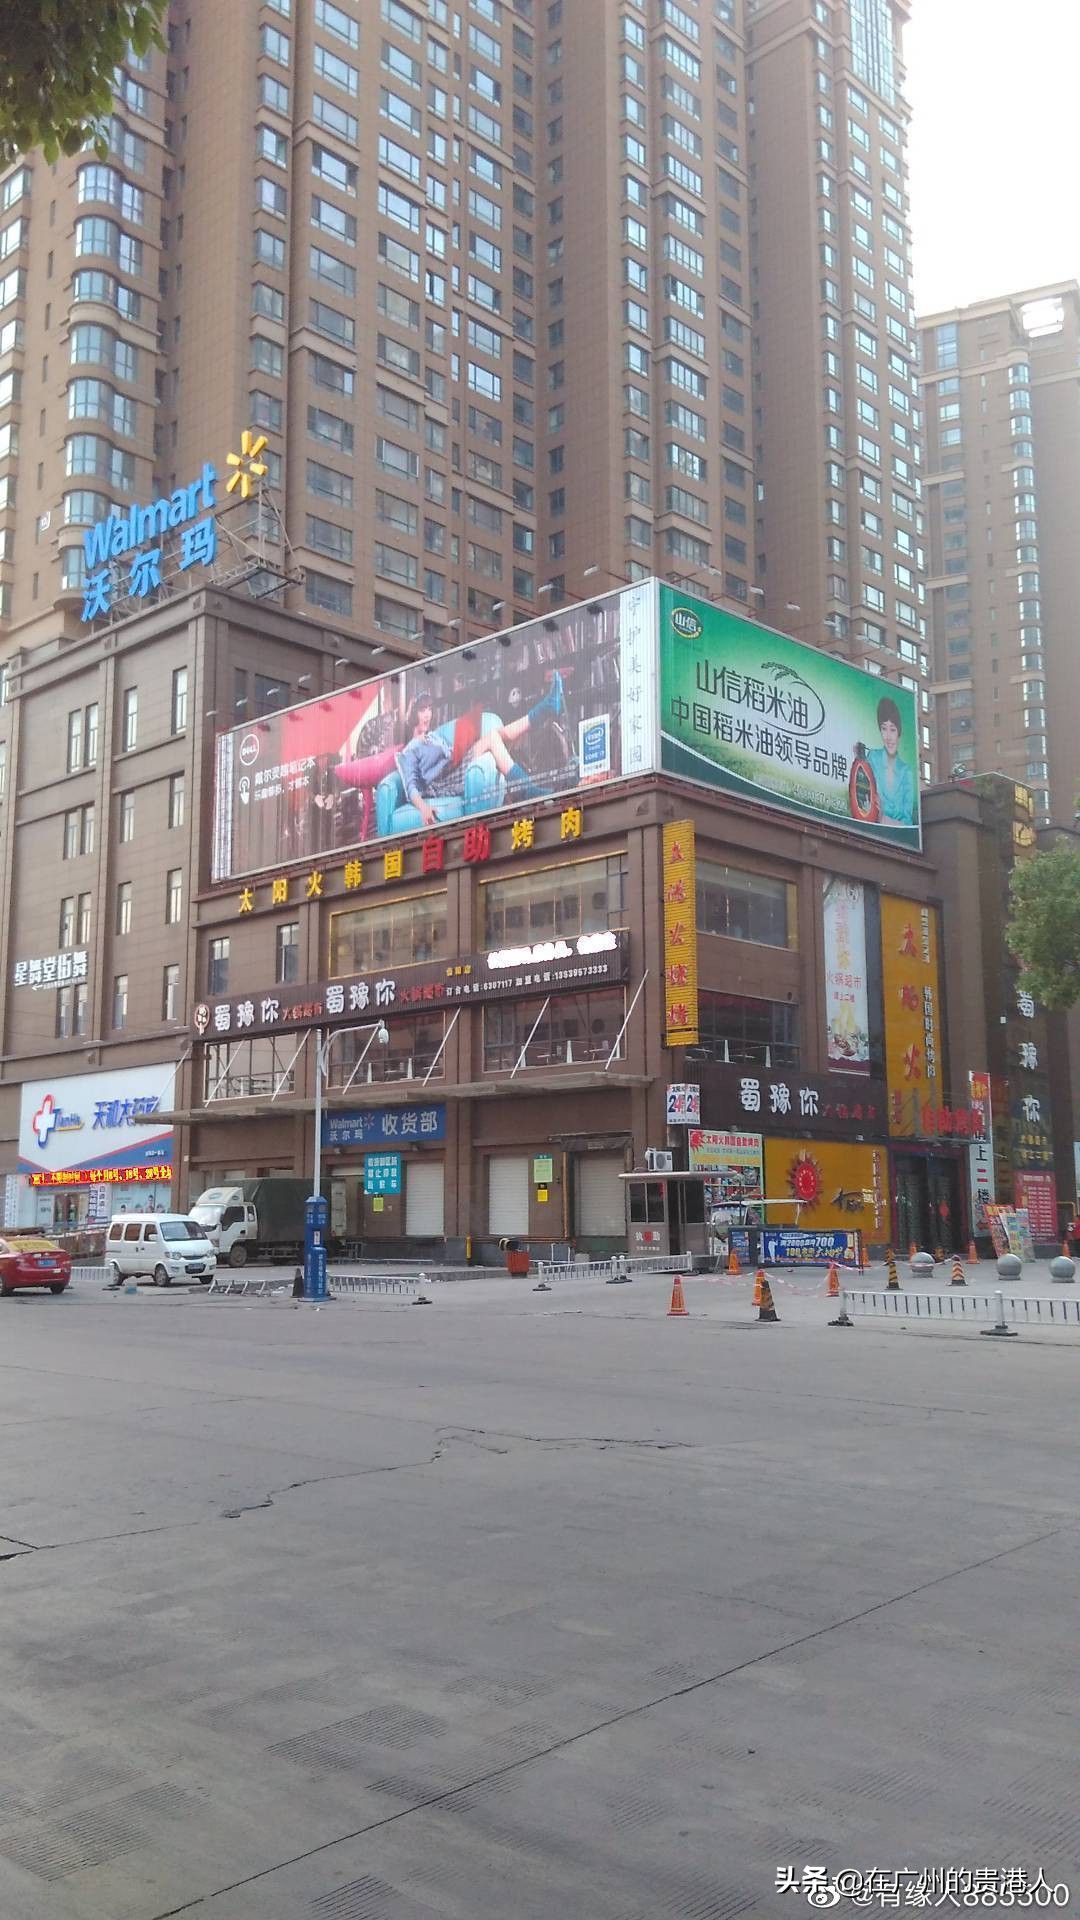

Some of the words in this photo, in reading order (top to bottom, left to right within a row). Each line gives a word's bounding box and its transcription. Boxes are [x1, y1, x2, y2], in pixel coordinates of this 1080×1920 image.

[83, 462, 217, 570] Walmart
[81, 517, 217, 623] 沃尔玛
[674, 612, 697, 632] 山信
[696, 659, 809, 729] 山信稻米油
[671, 695, 849, 783] 中国稻米油领导品牌
[740, 1077, 819, 1116] 蜀豫你
[329, 1117, 363, 1130] Walmart
[329, 1129, 363, 1142] 沃尔玛
[382, 1111, 437, 1135] 收货部
